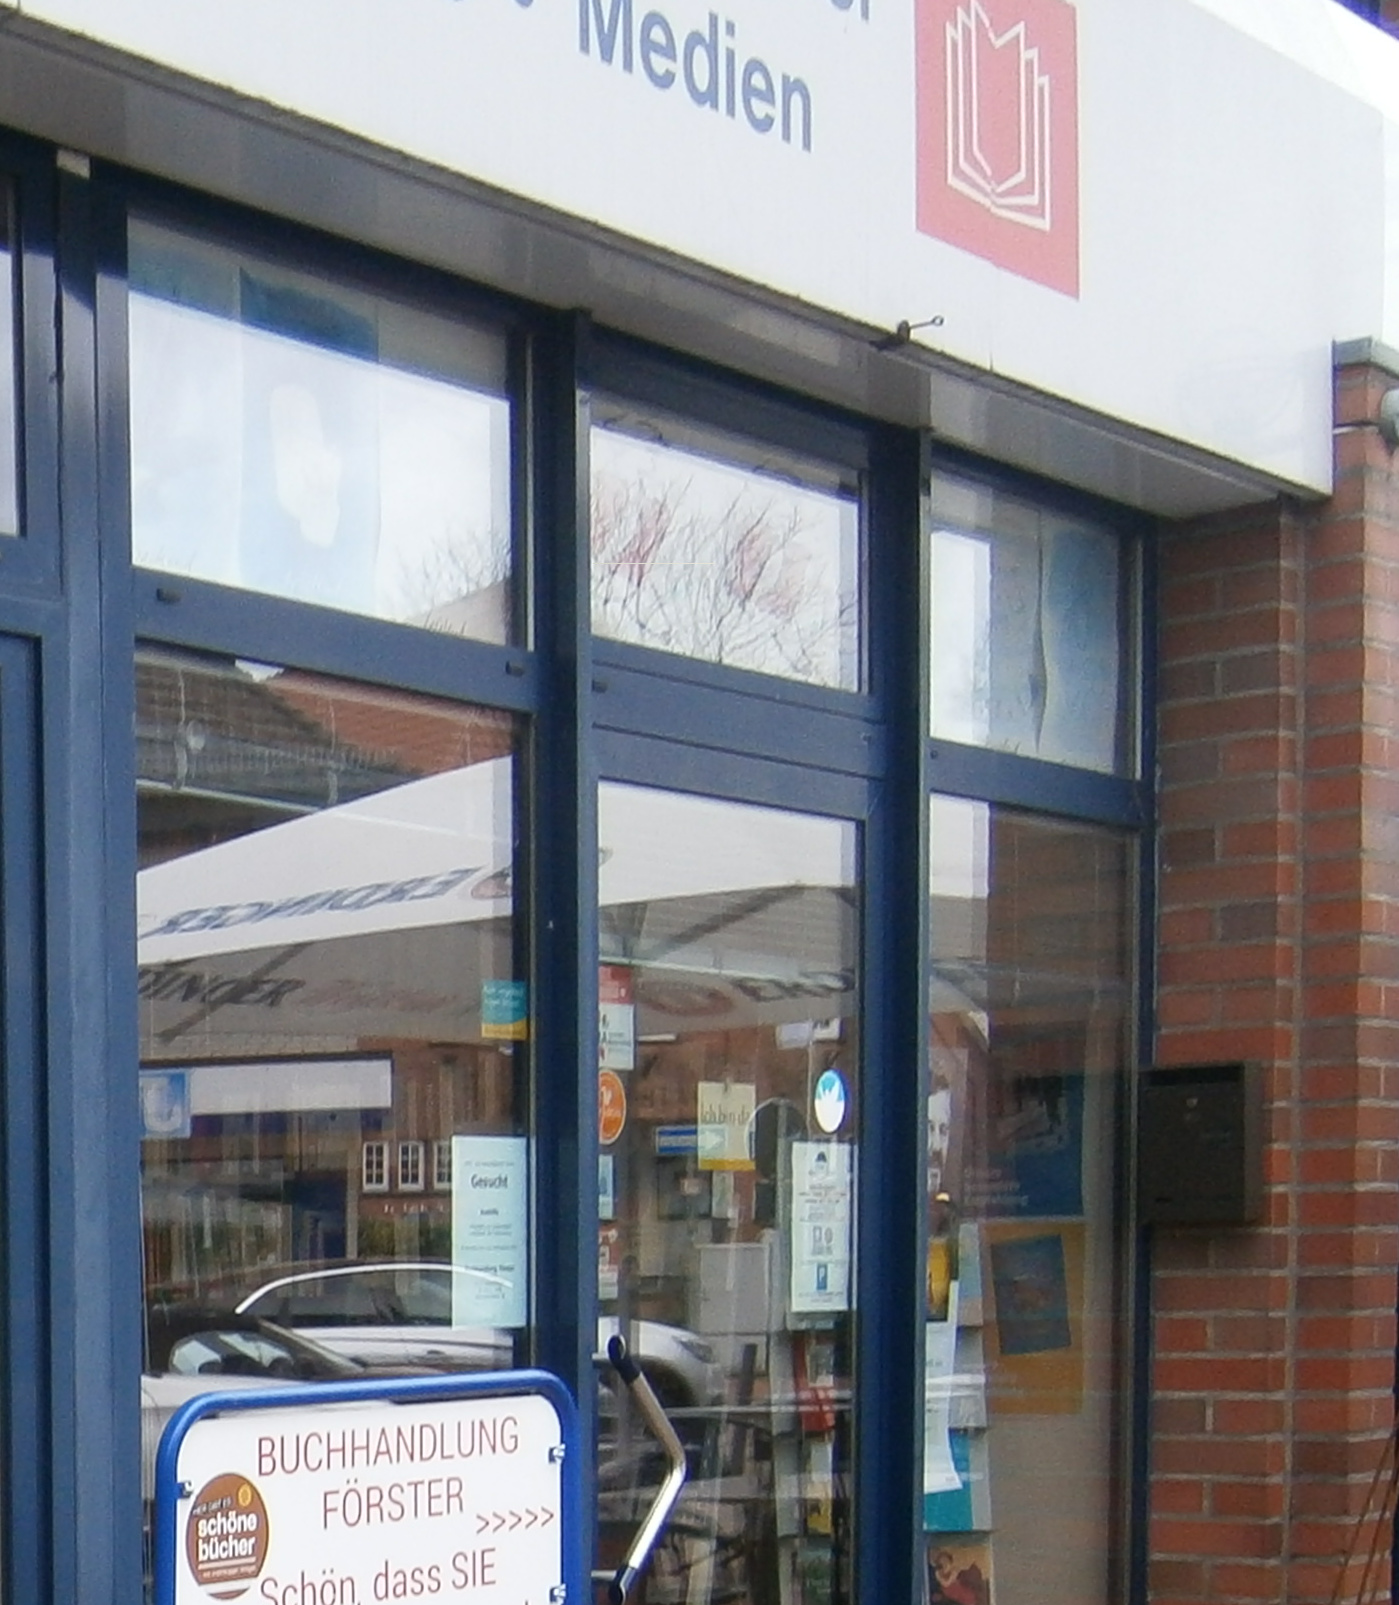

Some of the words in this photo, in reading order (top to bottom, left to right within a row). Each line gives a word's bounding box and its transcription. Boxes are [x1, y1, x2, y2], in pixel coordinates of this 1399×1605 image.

[578, 0, 812, 153] Medien
[257, 1415, 519, 1478] BUCHHANDLUNG
[197, 1509, 258, 1539] schöne
[322, 1476, 464, 1530] FÖRSTER
[197, 1534, 256, 1563] bücher
[372, 1559, 442, 1601] dass
[451, 1547, 497, 1591] SIE
